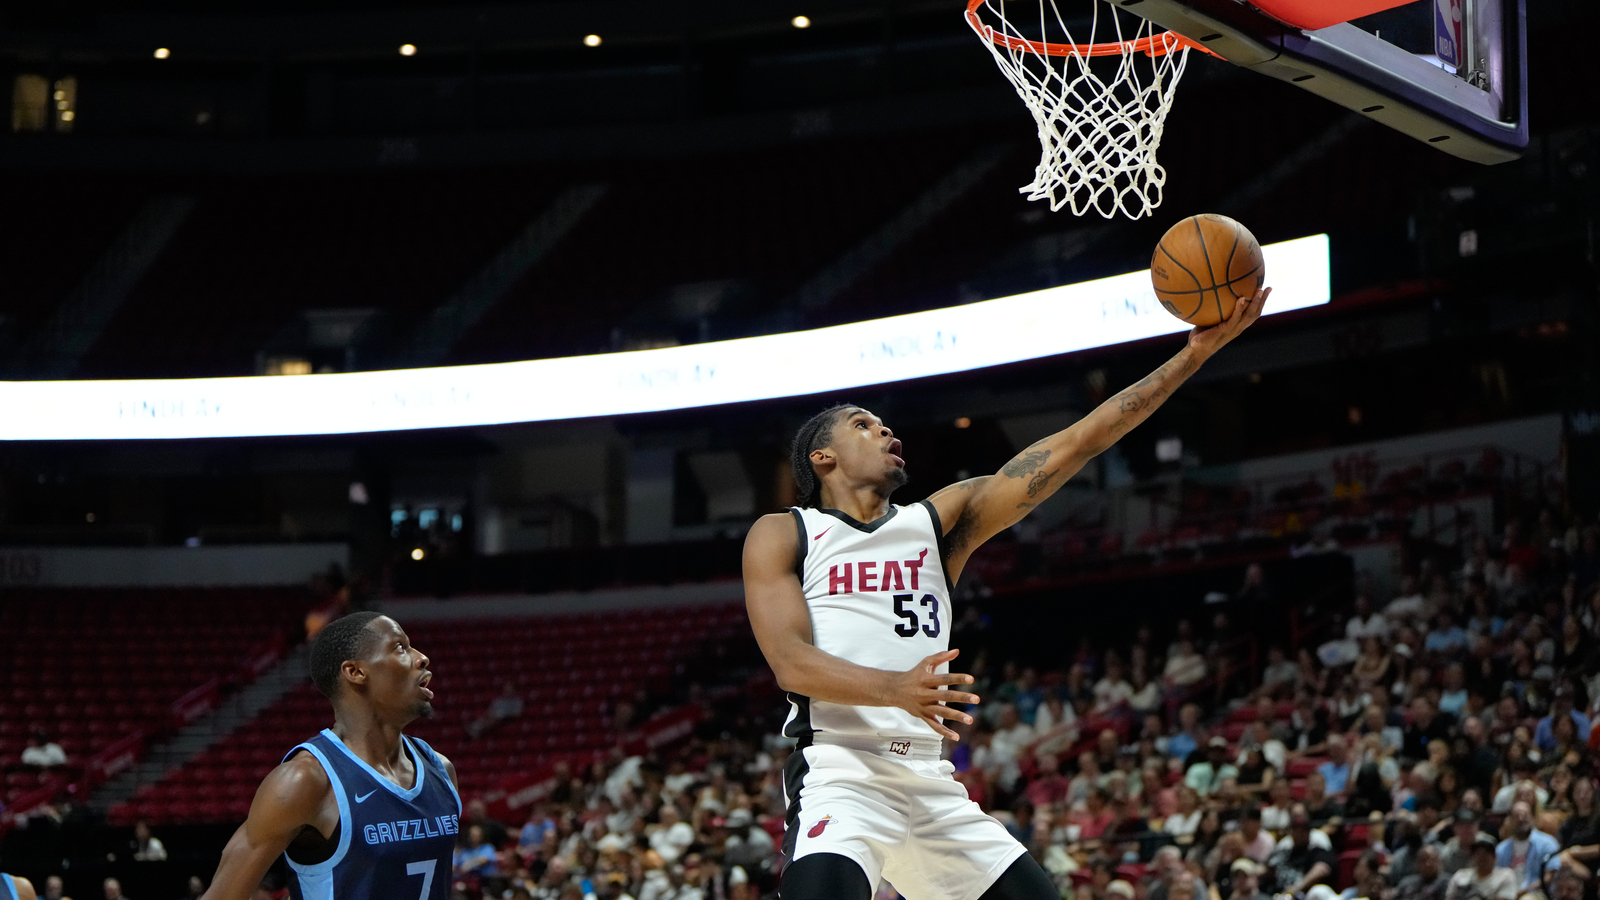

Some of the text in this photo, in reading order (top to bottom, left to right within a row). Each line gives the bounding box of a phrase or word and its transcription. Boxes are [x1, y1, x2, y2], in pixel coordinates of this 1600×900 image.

[1438, 36, 1453, 58] NBA
[828, 547, 929, 596] HEAT
[893, 593, 941, 638] 53
[363, 814, 459, 845] GRIZZLIES
[406, 858, 438, 900] 7
